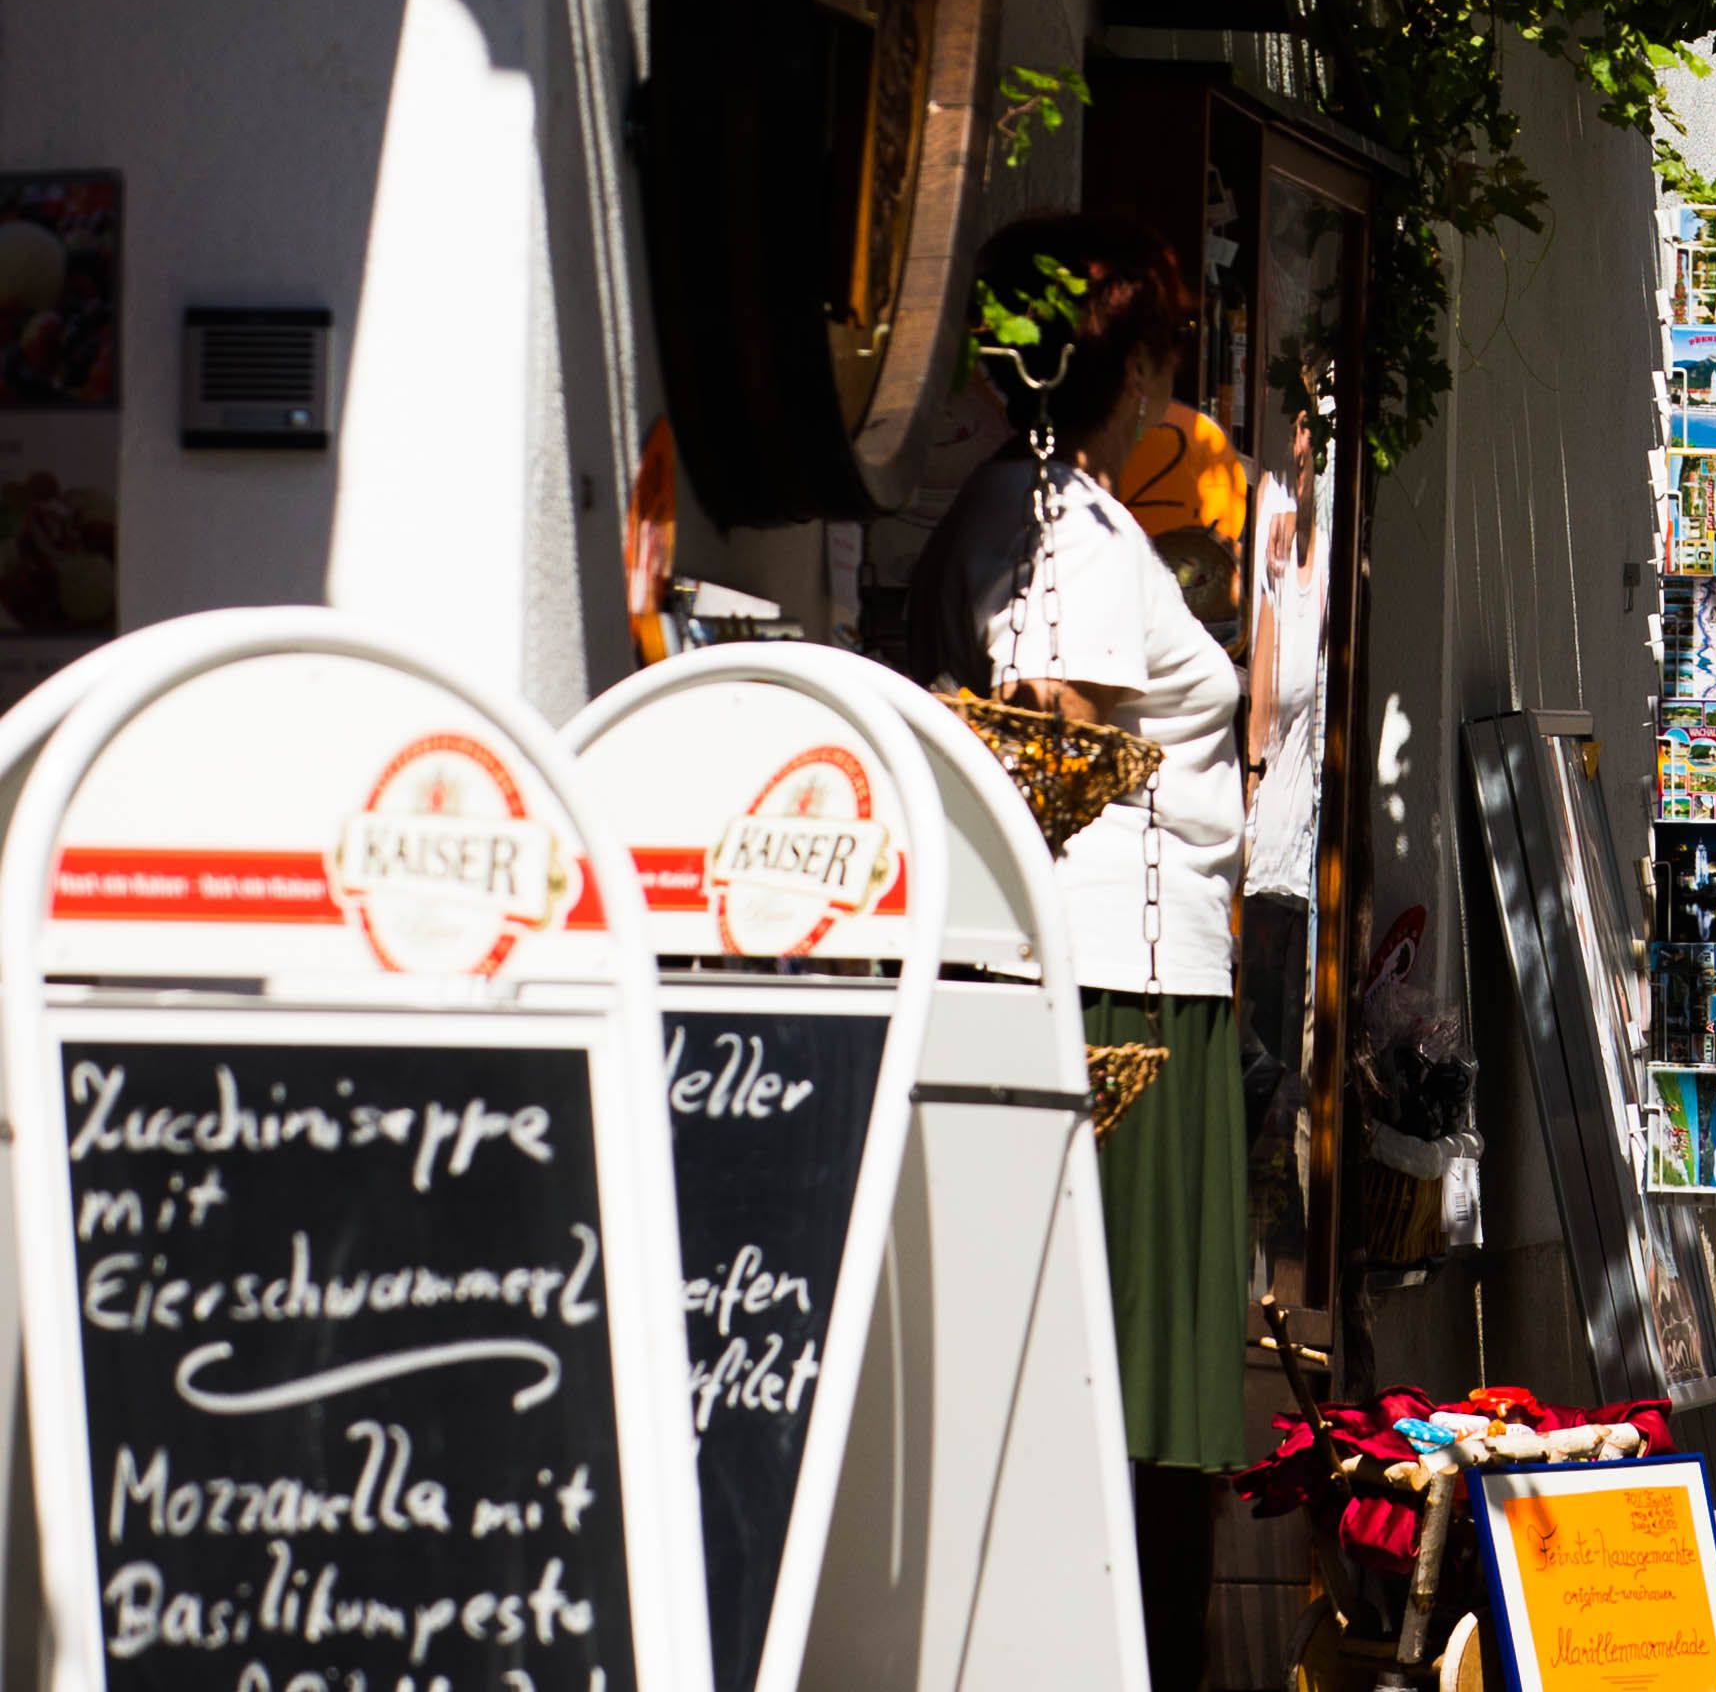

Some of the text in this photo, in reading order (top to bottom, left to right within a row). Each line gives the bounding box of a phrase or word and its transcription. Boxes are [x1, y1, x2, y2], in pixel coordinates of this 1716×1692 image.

[363, 825, 518, 896] KAISER
[732, 826, 857, 887] KAISER
[78, 1166, 227, 1242] mit
[109, 1419, 596, 1544] Mozzarella mit
[103, 1540, 594, 1664] Basilikumpesto
